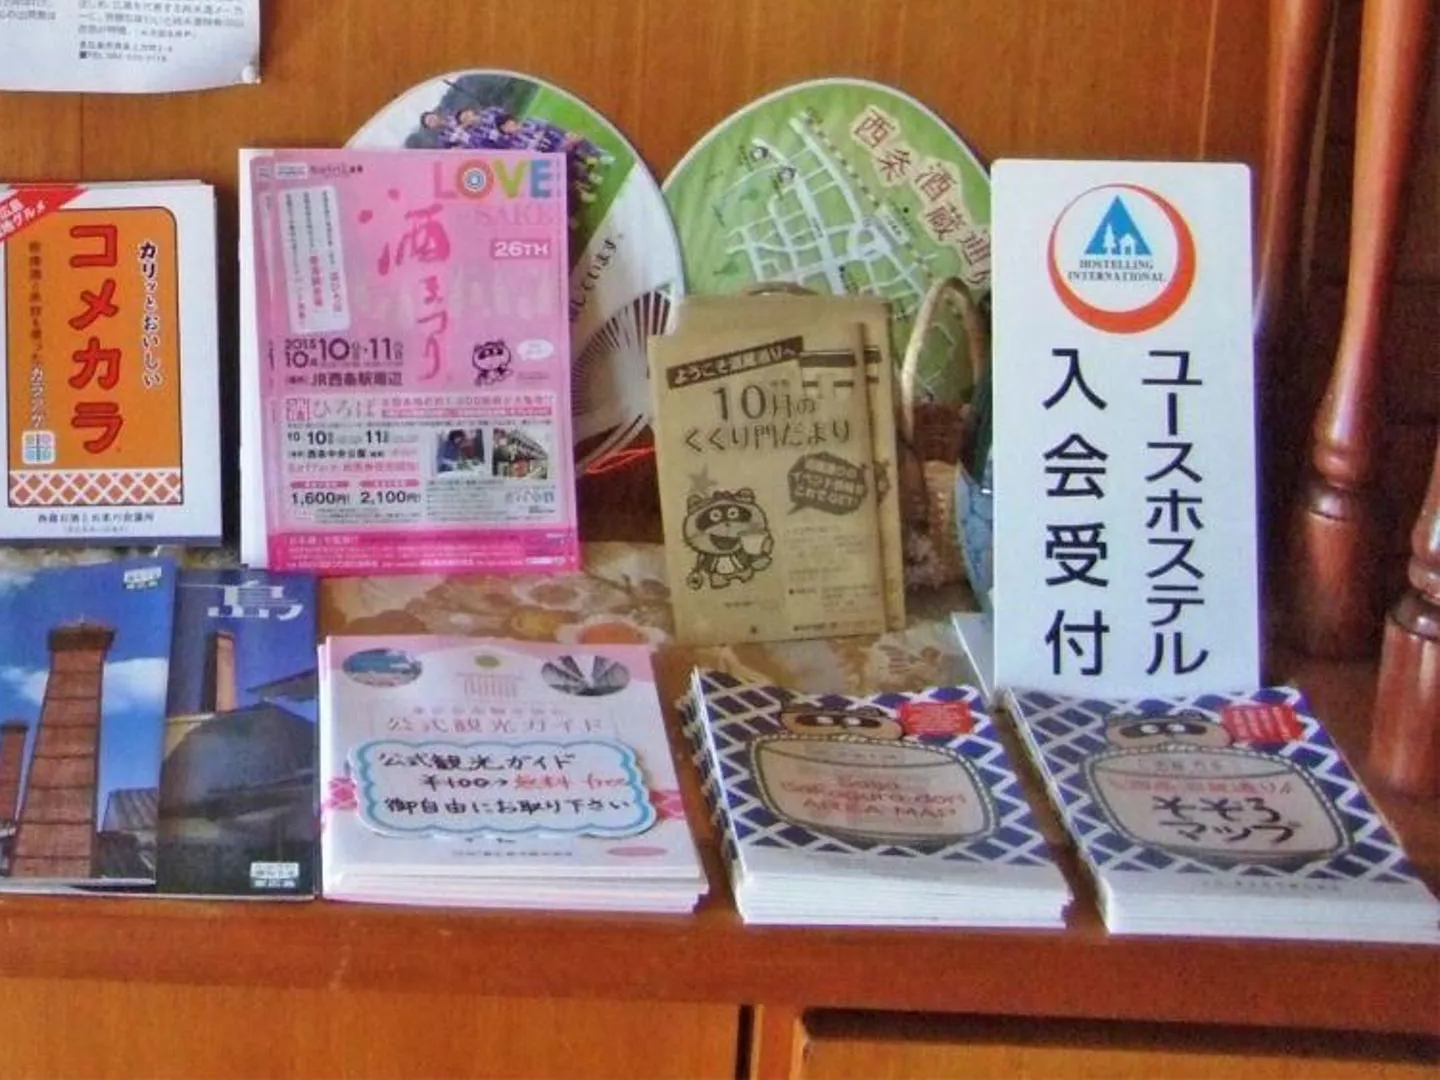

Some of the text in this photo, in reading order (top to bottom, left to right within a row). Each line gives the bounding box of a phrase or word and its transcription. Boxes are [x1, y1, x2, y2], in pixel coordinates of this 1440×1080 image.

[433, 159, 551, 201] LOVE
[493, 241, 549, 257] 26TH
[1067, 271, 1165, 282] INTERNATIONAL
[68, 224, 124, 454] コメカラ
[1042, 348, 1110, 676] 入会受付
[1141, 349, 1209, 676] ユースホステル
[378, 752, 576, 771] 公式観光ガイド
[383, 797, 631, 816] 御自由にお取り下さい
